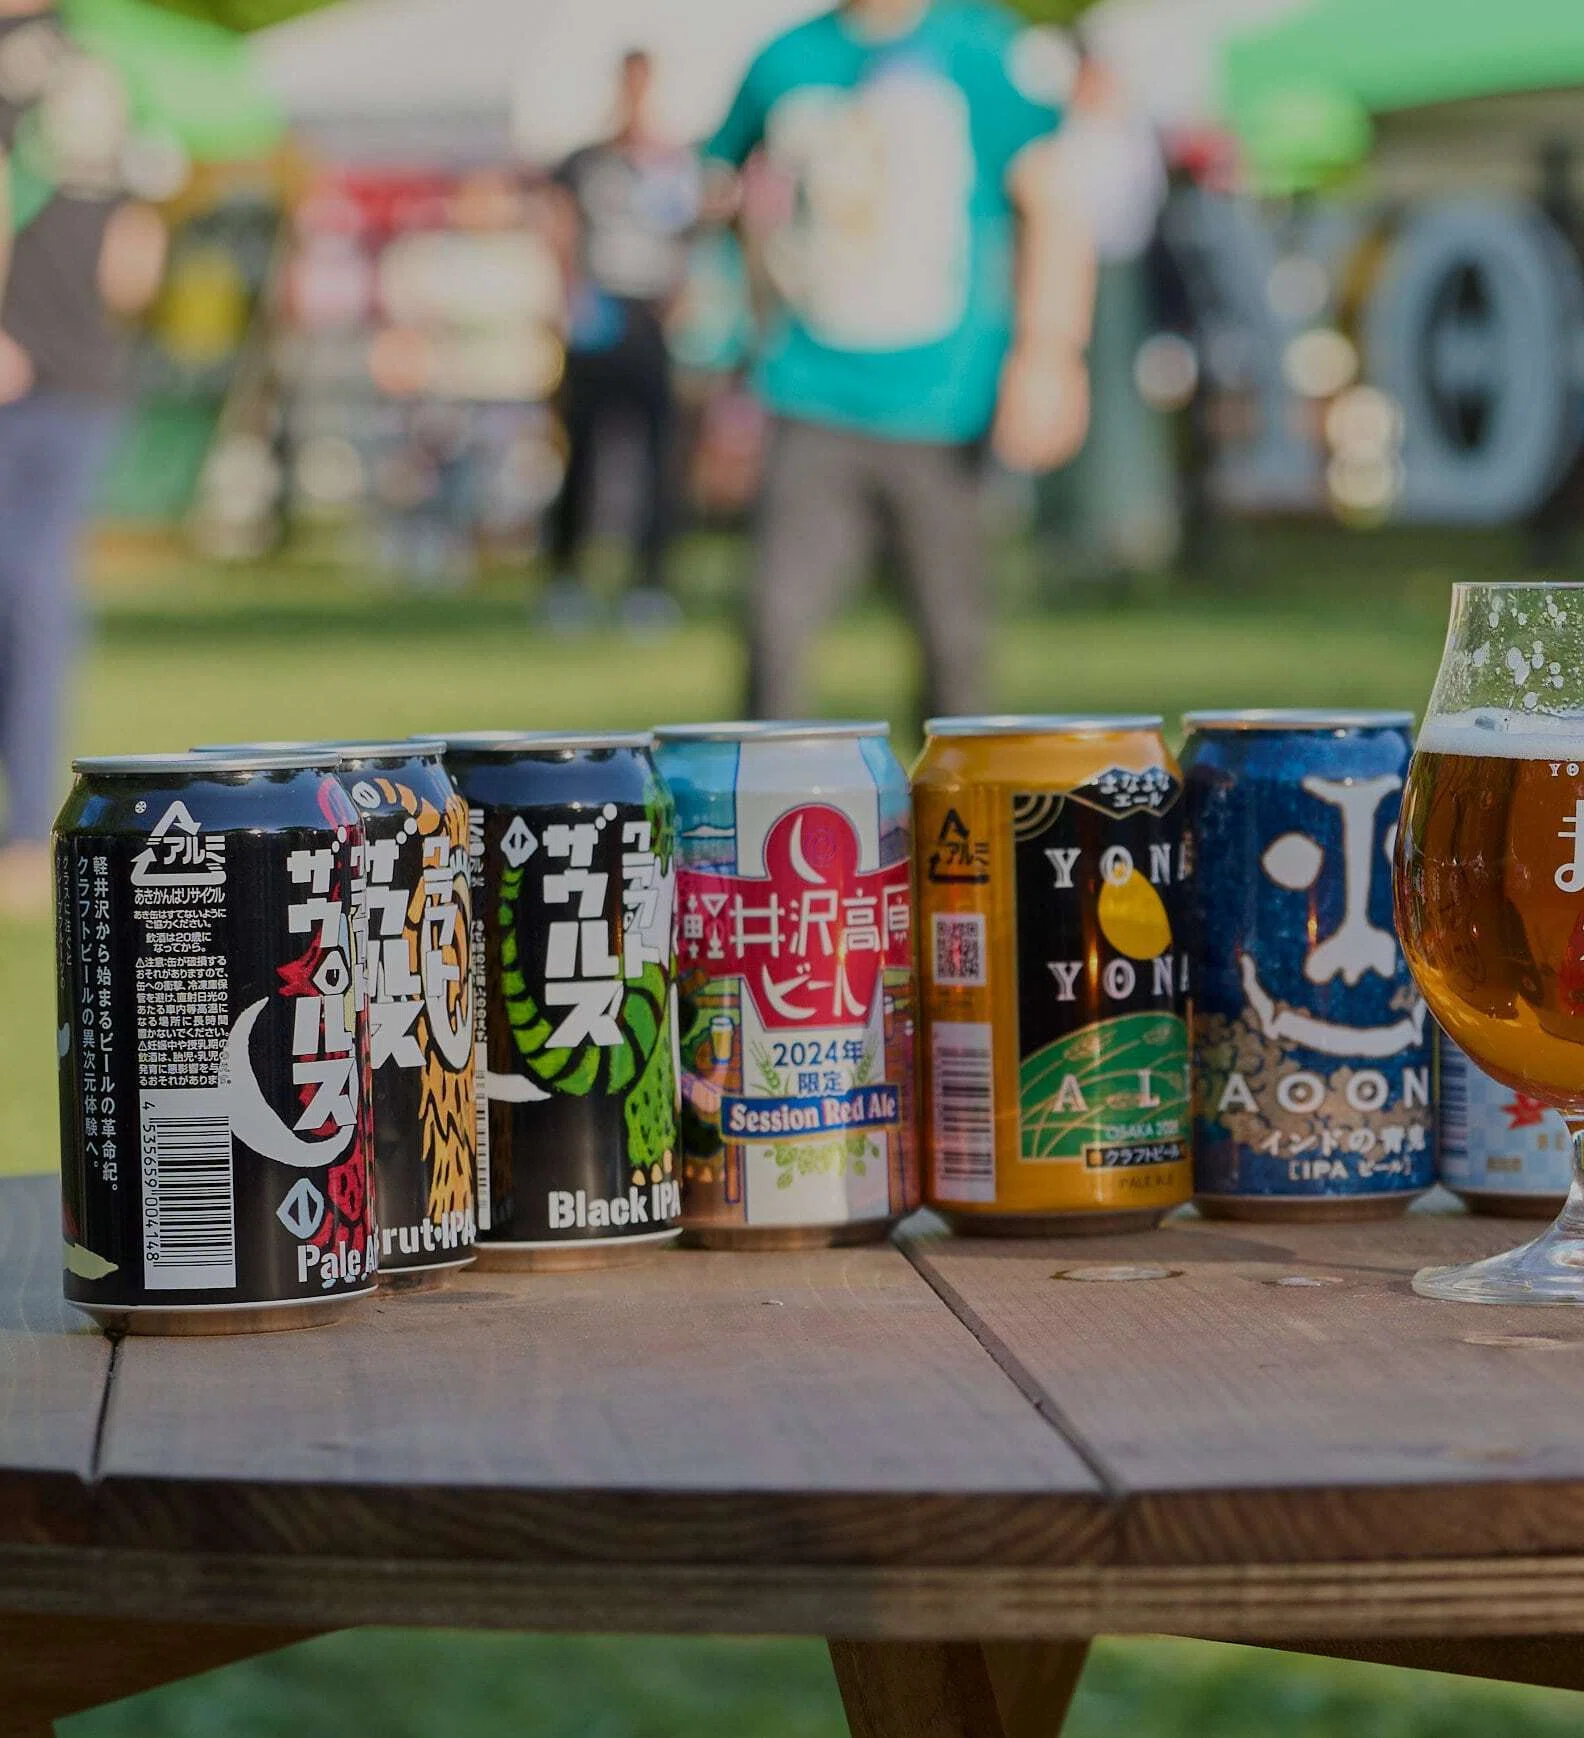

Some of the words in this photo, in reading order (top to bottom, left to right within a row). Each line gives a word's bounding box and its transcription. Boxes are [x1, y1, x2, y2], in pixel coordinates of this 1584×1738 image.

[163, 835, 226, 865] アルミ
[134, 886, 226, 905] あきかんはリサイクル
[133, 908, 227, 920] あき缶はすてないように
[145, 919, 212, 930] ご協力ください。
[541, 802, 625, 1049] ザウルス
[682, 884, 911, 960] 軽井沢高原
[145, 931, 212, 943] 飲酒は20歳に
[153, 943, 207, 953] なってから。
[135, 967, 229, 979] おそれがありますので、
[760, 962, 867, 1020] ビール
[77, 855, 99, 1168] クラフトビールの異次元体験へ。
[92, 855, 118, 1192] 軽井沢から始まるビールの革命紀。
[137, 1014, 229, 1026] なる場所に長時間
[137, 1026, 230, 1039] 置かないでください。
[772, 1039, 865, 1068] 2024年
[796, 1070, 845, 1095] 限定
[728, 1102, 821, 1134] Session
[822, 1094, 865, 1125] Red
[867, 1091, 897, 1119] Ale
[142, 1123, 158, 1188] 535659
[548, 1185, 649, 1229] Black
[651, 1179, 682, 1221] IPA
[144, 1196, 160, 1261] 004148
[376, 1217, 436, 1256] rut
[297, 1240, 361, 1283] Pale
